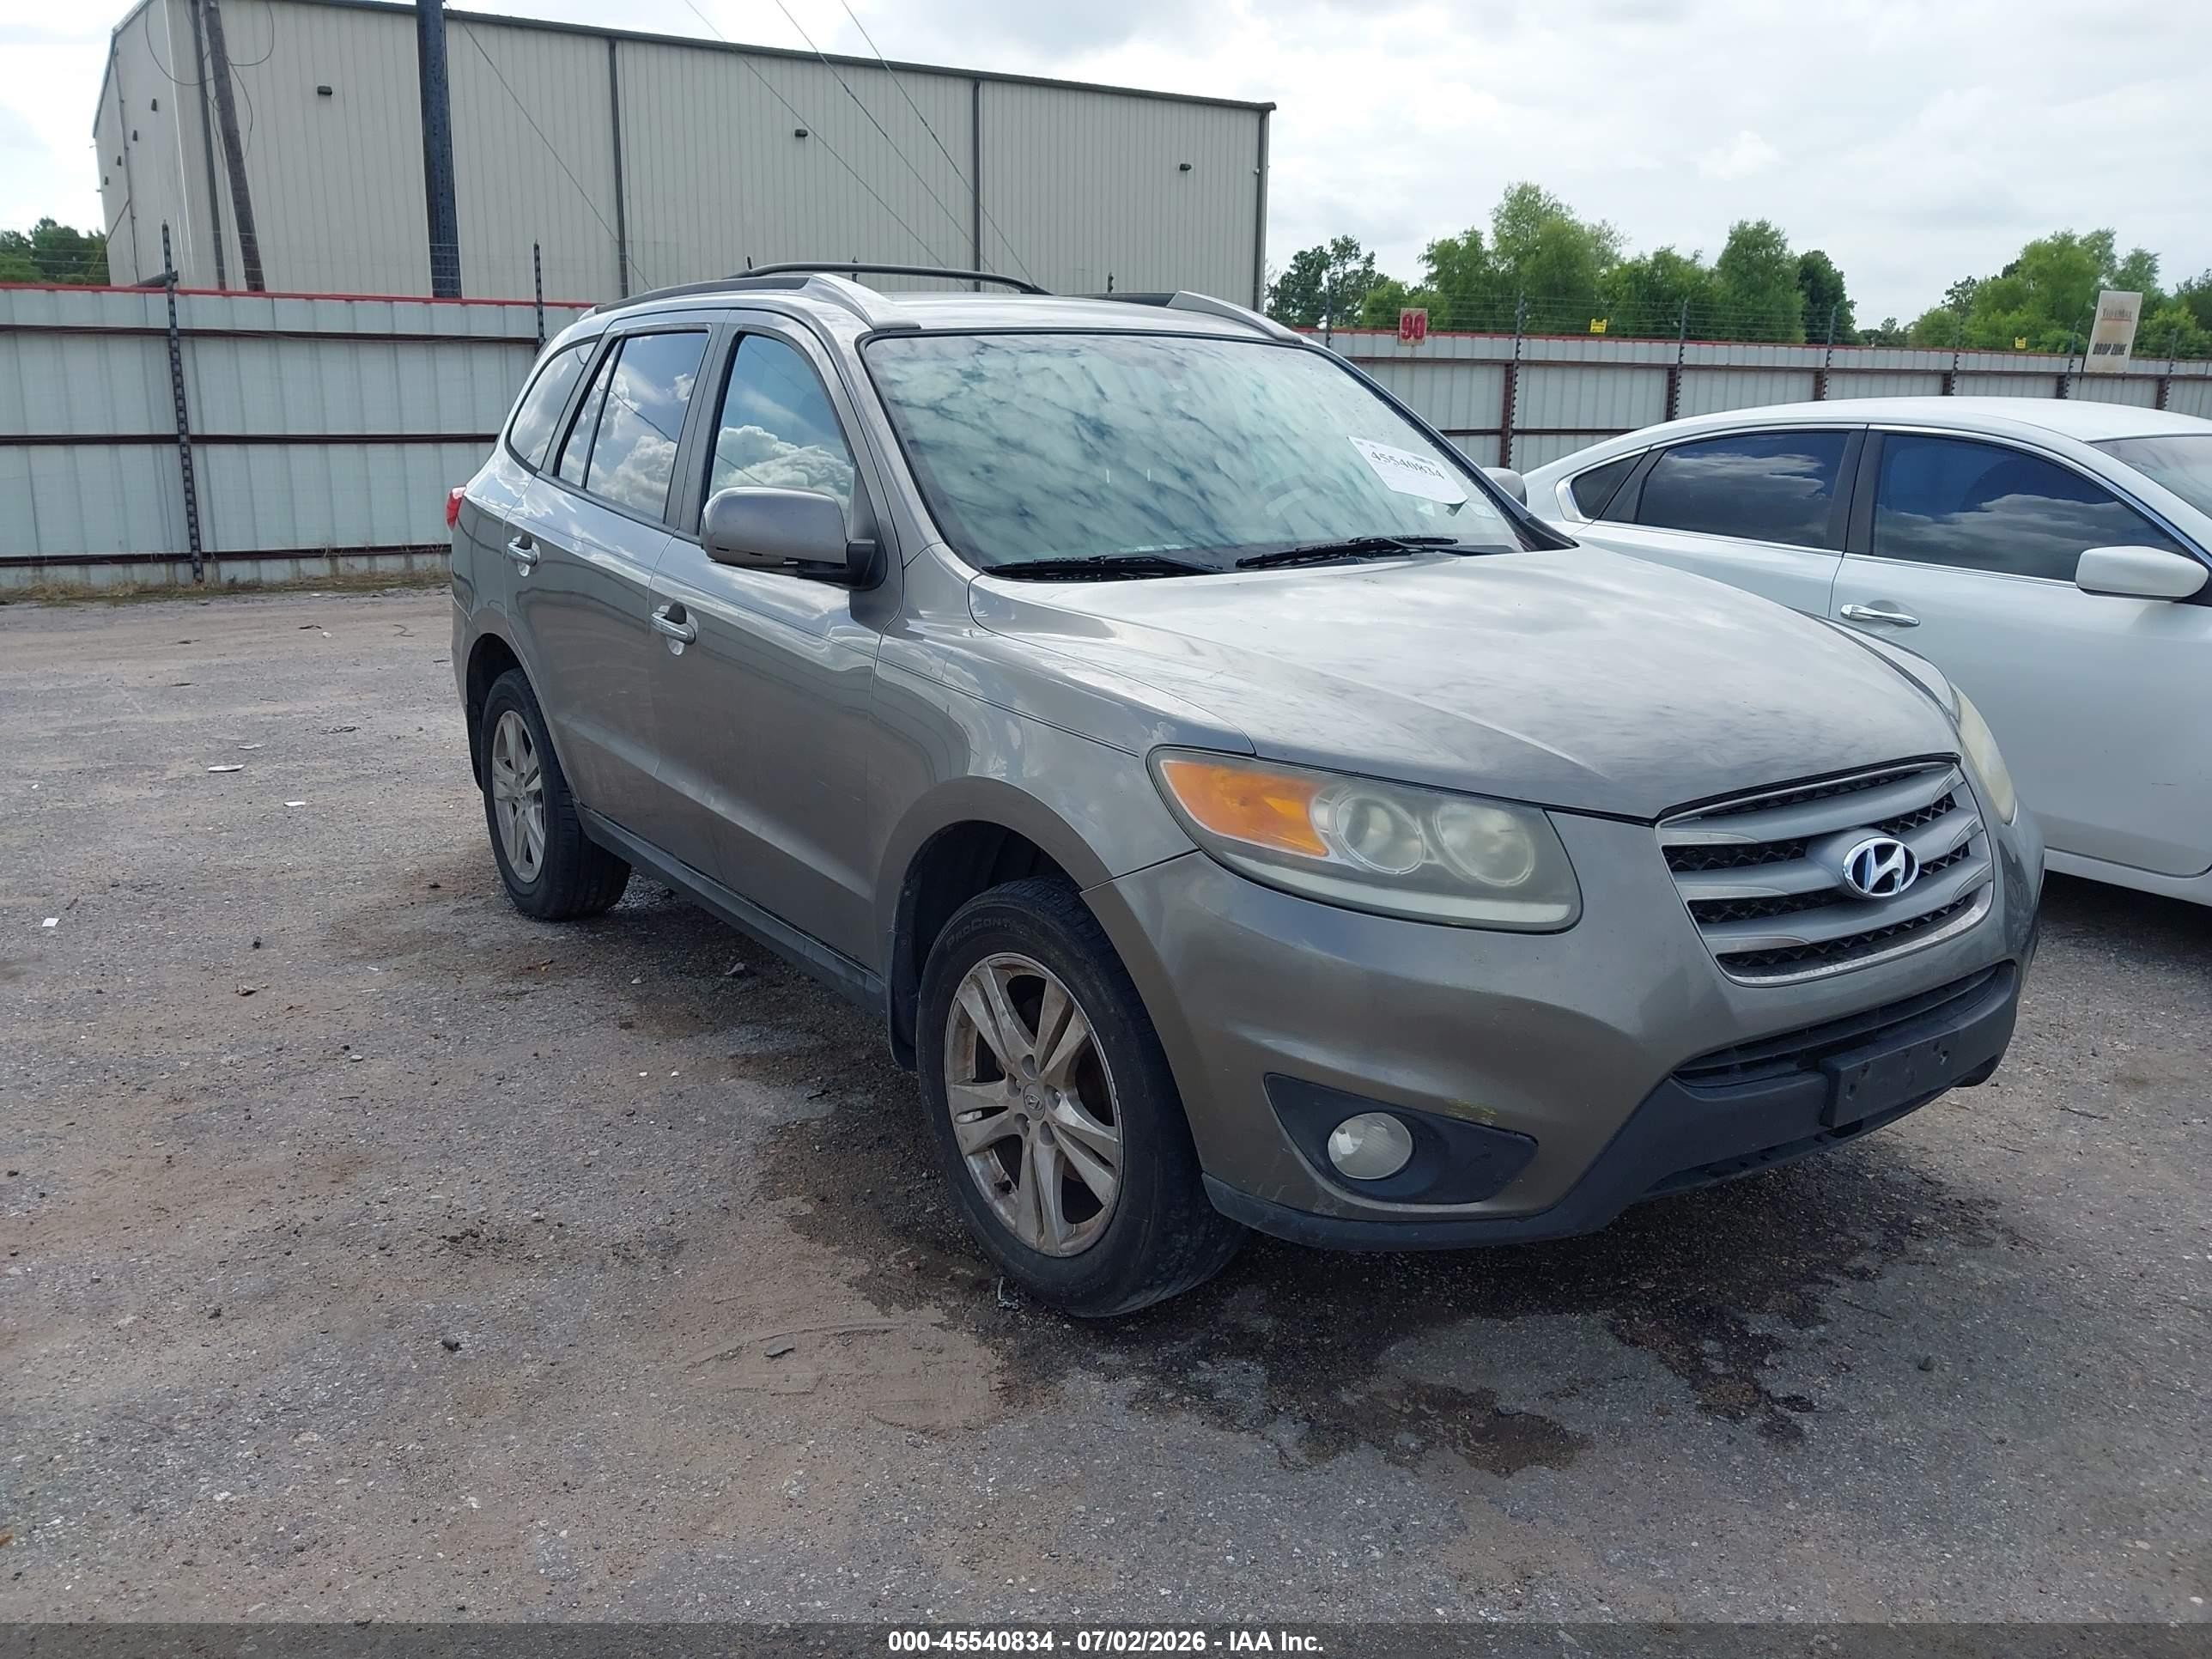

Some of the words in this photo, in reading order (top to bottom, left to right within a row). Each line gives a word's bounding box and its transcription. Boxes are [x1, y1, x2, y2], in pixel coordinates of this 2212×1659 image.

[1401, 314, 1426, 340] 90
[2093, 343, 2112, 356] DROP
[2111, 343, 2128, 356] ZONE
[1370, 451, 1444, 480] 45540834
